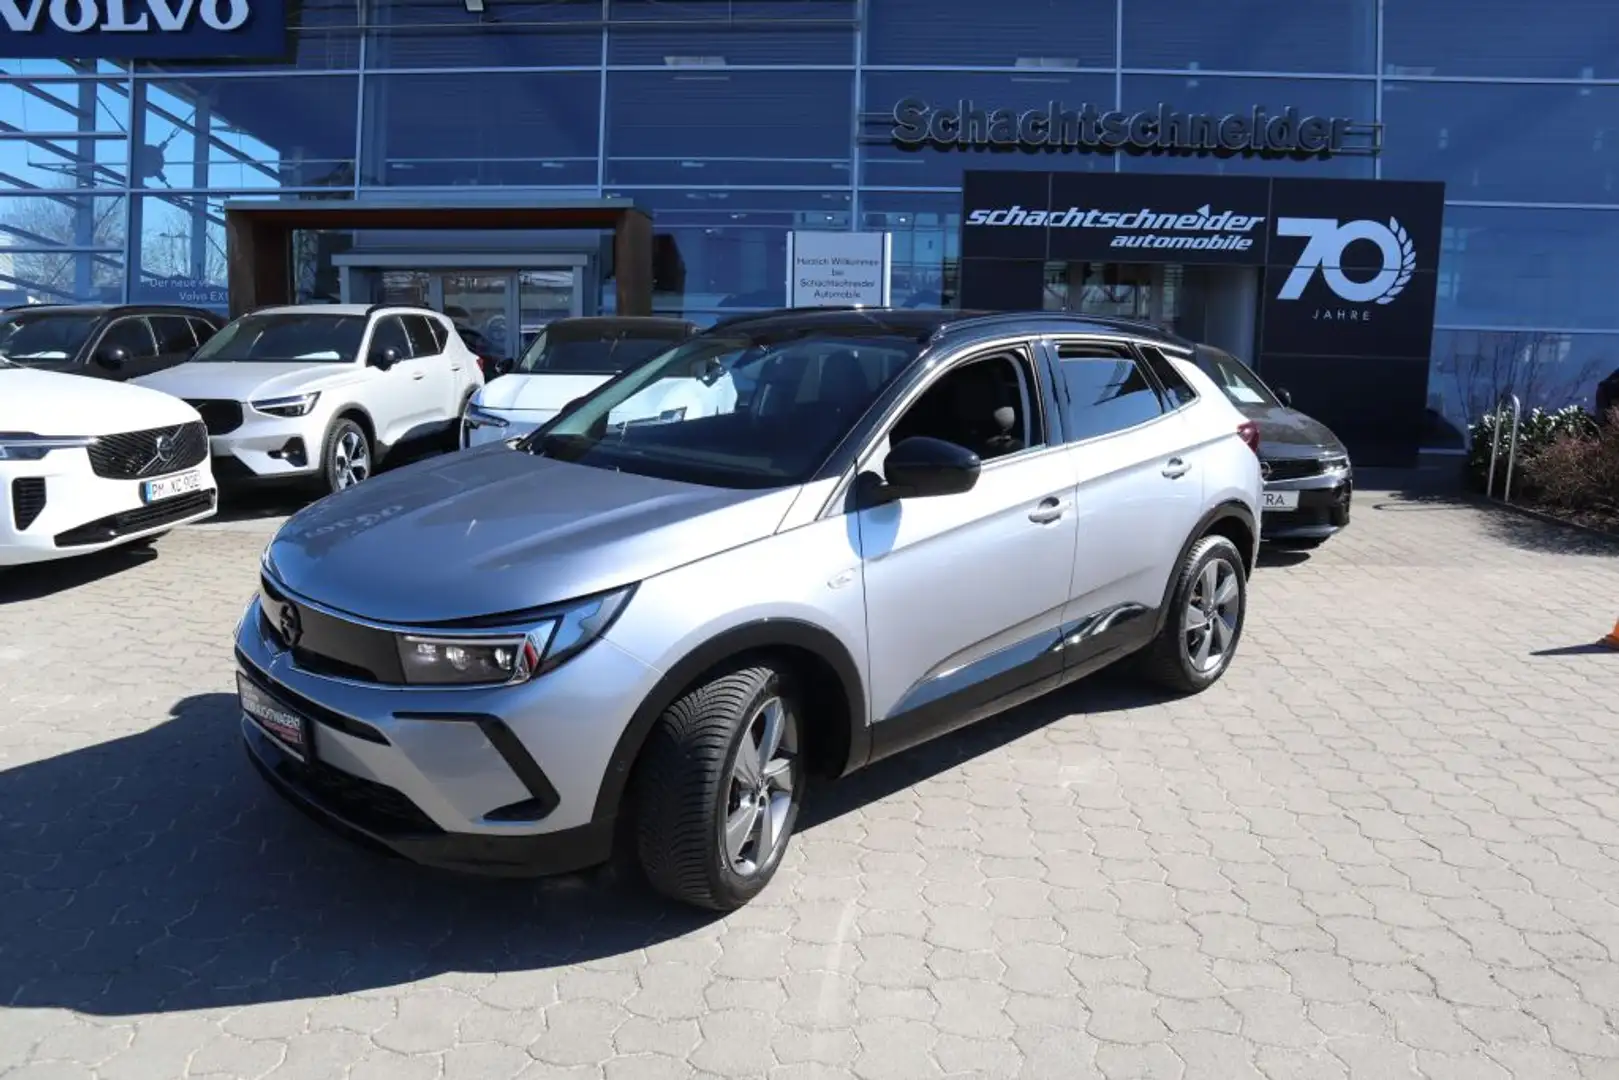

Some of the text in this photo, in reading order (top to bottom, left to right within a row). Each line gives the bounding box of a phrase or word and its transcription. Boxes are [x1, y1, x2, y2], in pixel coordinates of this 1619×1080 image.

[0, 0, 250, 32] VOLVO
[892, 98, 1350, 154] Schachtschneider
[966, 204, 1265, 232] schachtschneider
[1110, 234, 1253, 250] automobile
[831, 257, 880, 266] Willkommen
[1276, 217, 1402, 304] 70
[151, 279, 170, 288] Der
[180, 291, 229, 302] Volvo EX
[814, 290, 862, 299] Automobile
[1312, 310, 1372, 321] JAHRE
